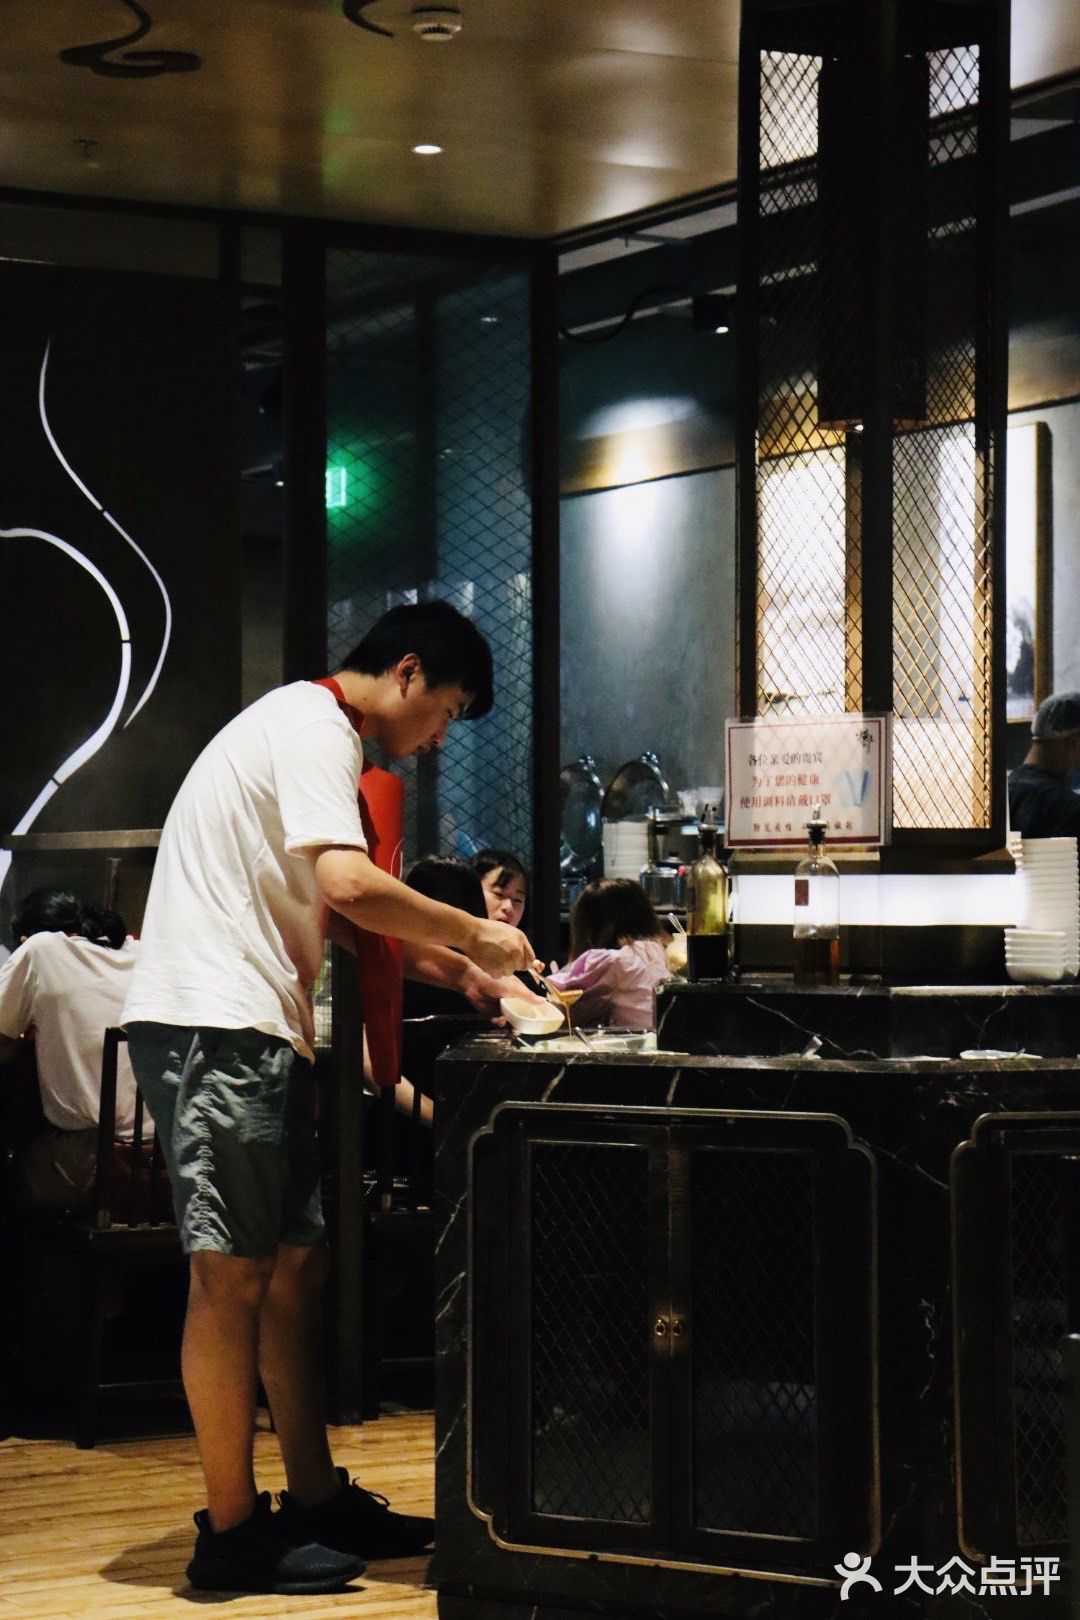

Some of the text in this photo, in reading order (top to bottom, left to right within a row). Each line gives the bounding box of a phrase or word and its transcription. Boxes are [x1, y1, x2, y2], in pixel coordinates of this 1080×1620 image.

[752, 773, 820, 787] 为了您的健康
